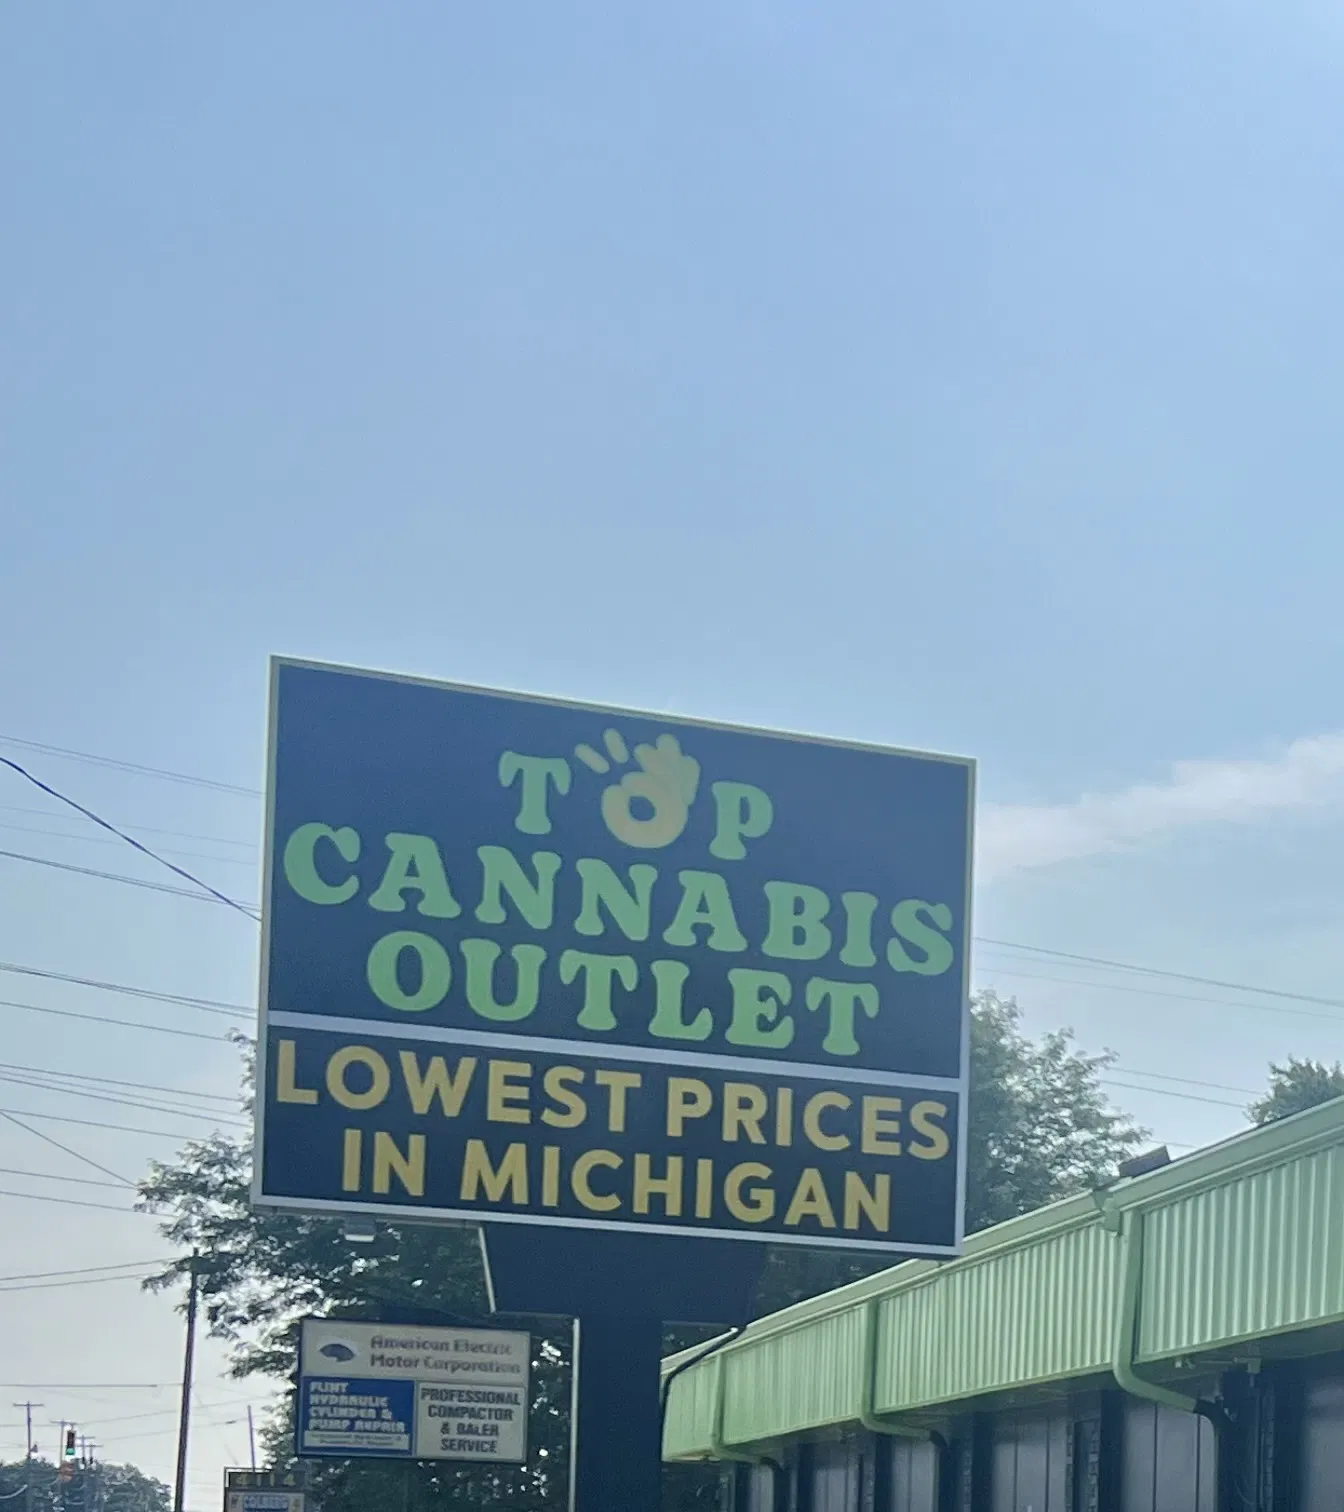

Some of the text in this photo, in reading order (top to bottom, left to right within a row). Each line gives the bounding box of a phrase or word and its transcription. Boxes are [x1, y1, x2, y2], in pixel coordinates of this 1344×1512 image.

[284, 822, 953, 976] CANNABIS
[367, 930, 880, 1056] OUTLET
[276, 1038, 950, 1160] LOWEST PRICES
[342, 1128, 892, 1233] IN MICHIGAN
[370, 1335, 449, 1352] American
[370, 1353, 521, 1375] Motor Corporation
[421, 1387, 521, 1405] PROFESSIONAL
[428, 1404, 513, 1421] COMPACTOR
[440, 1422, 499, 1437] & BALER
[440, 1438, 497, 1454] SERVICE
